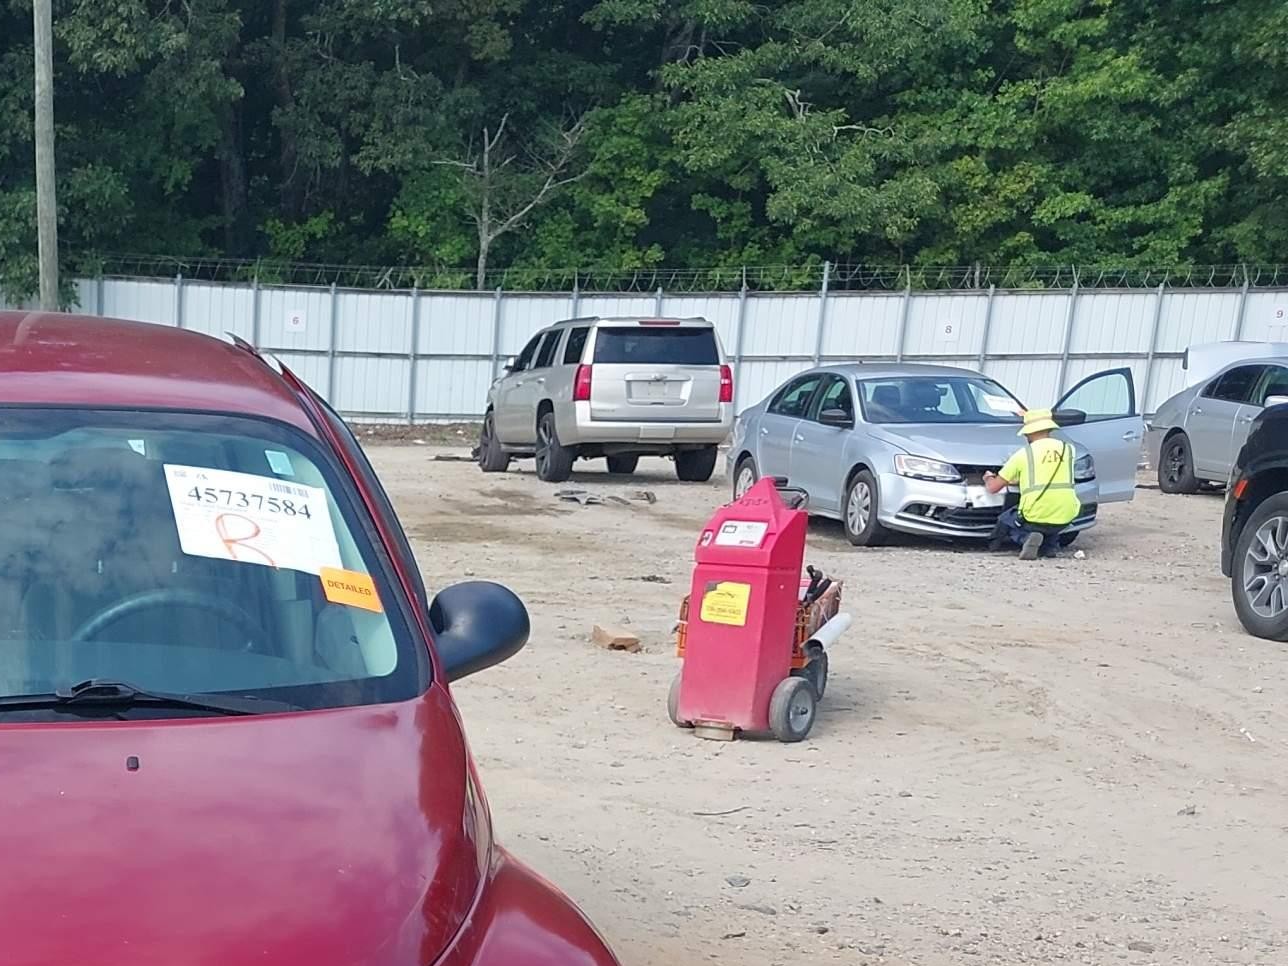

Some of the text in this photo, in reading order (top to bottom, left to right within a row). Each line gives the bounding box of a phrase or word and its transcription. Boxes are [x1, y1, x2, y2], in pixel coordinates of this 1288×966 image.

[1276, 310, 1284, 319] 9
[945, 325, 953, 334] 8
[187, 486, 312, 520] 45737584
[215, 512, 279, 571] R
[327, 580, 372, 596] DETAILED
